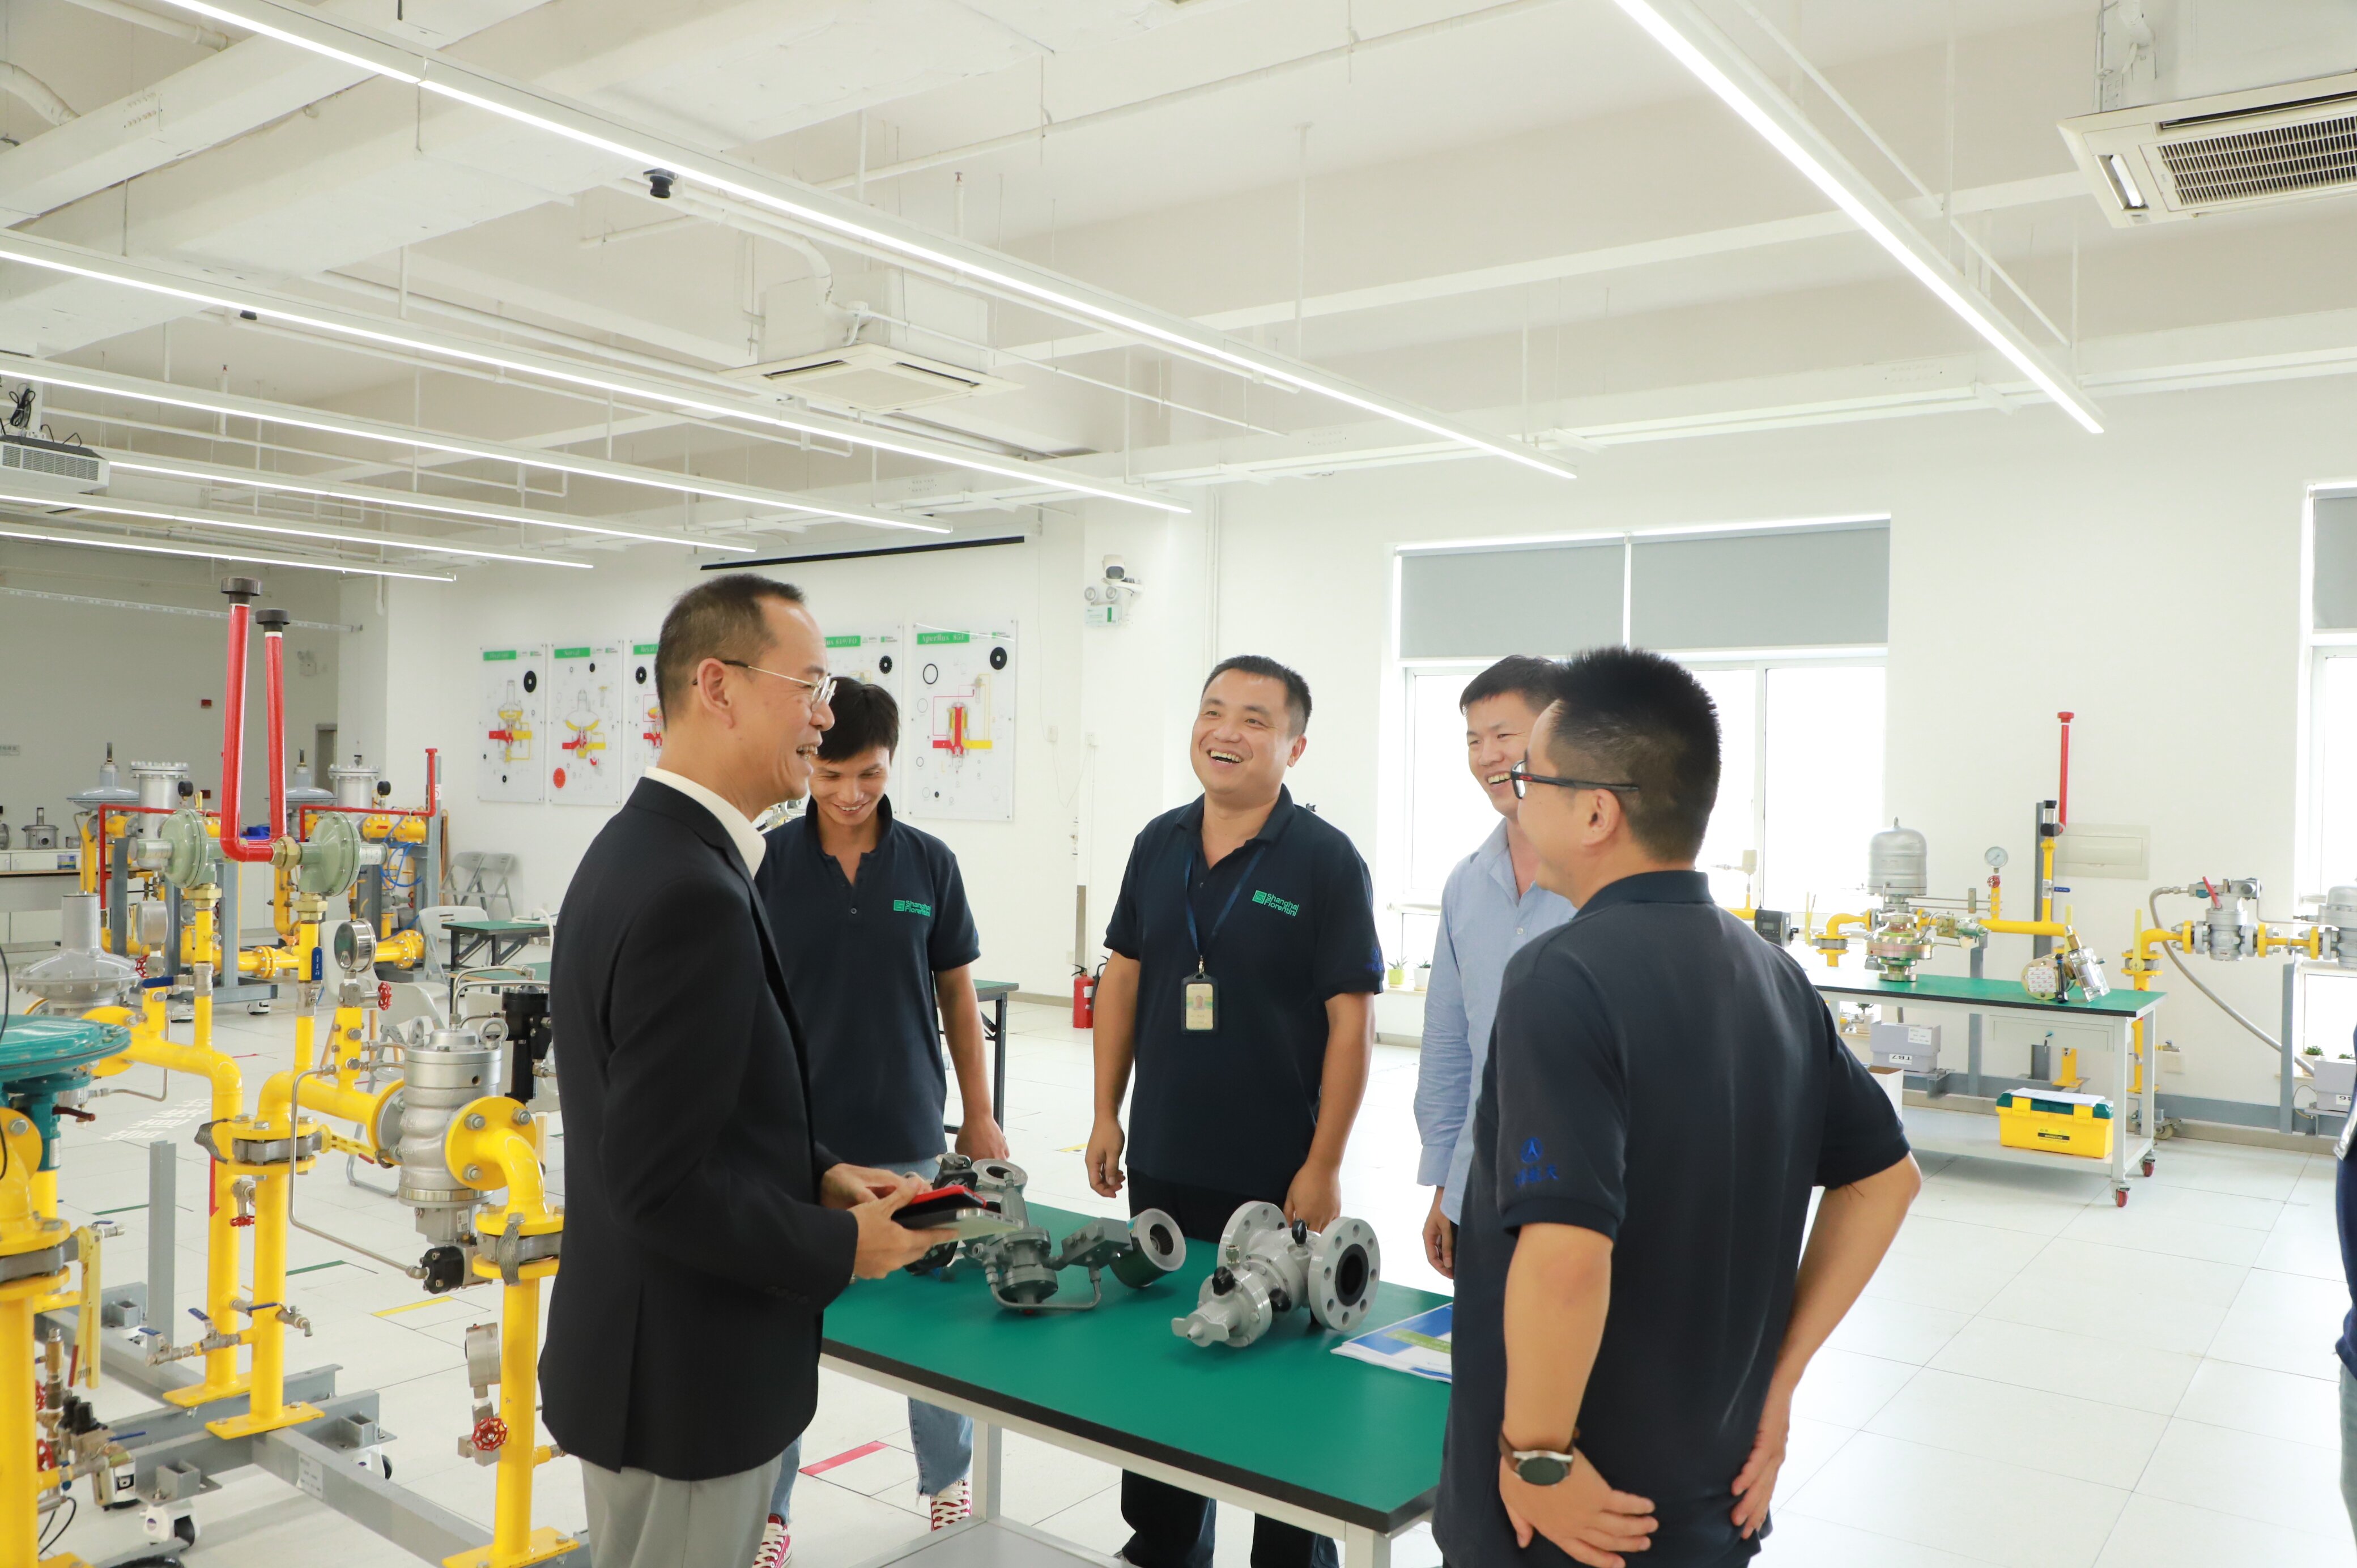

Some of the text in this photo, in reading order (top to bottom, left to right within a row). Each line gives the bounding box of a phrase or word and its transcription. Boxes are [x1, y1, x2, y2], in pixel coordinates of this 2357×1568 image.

[921, 633, 950, 644] Aperflux
[1263, 899, 1296, 917] Fiorentini
[1267, 893, 1299, 910] Shanghai
